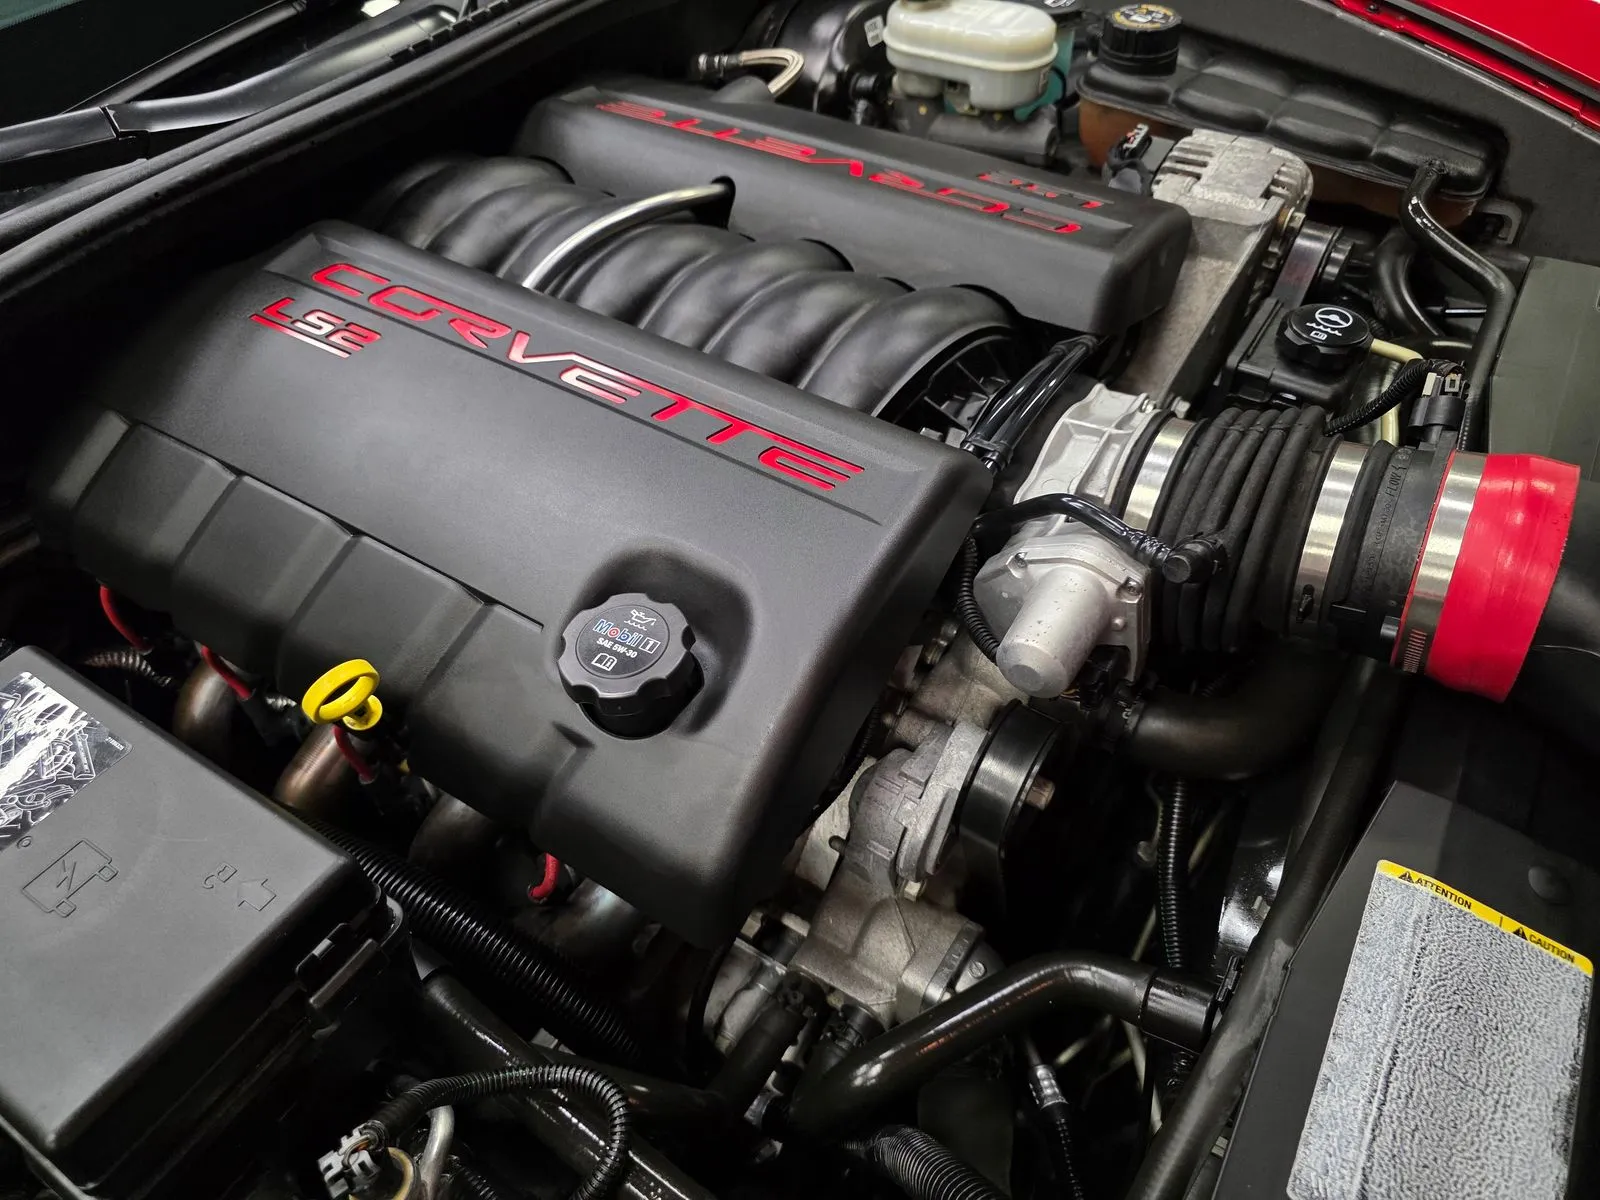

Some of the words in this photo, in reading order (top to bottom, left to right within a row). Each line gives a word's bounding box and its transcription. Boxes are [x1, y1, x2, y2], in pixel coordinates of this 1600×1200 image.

[595, 100, 1082, 233] CORVETTE
[252, 296, 382, 358] LS2
[311, 262, 865, 491] CORVETTE
[1385, 470, 1402, 498] FLOW
[592, 618, 643, 647] Mobil
[596, 637, 613, 649] SAE
[612, 642, 638, 659] 5W-30
[1416, 877, 1472, 910] ATTENTION
[1529, 934, 1575, 964] CAUTION
